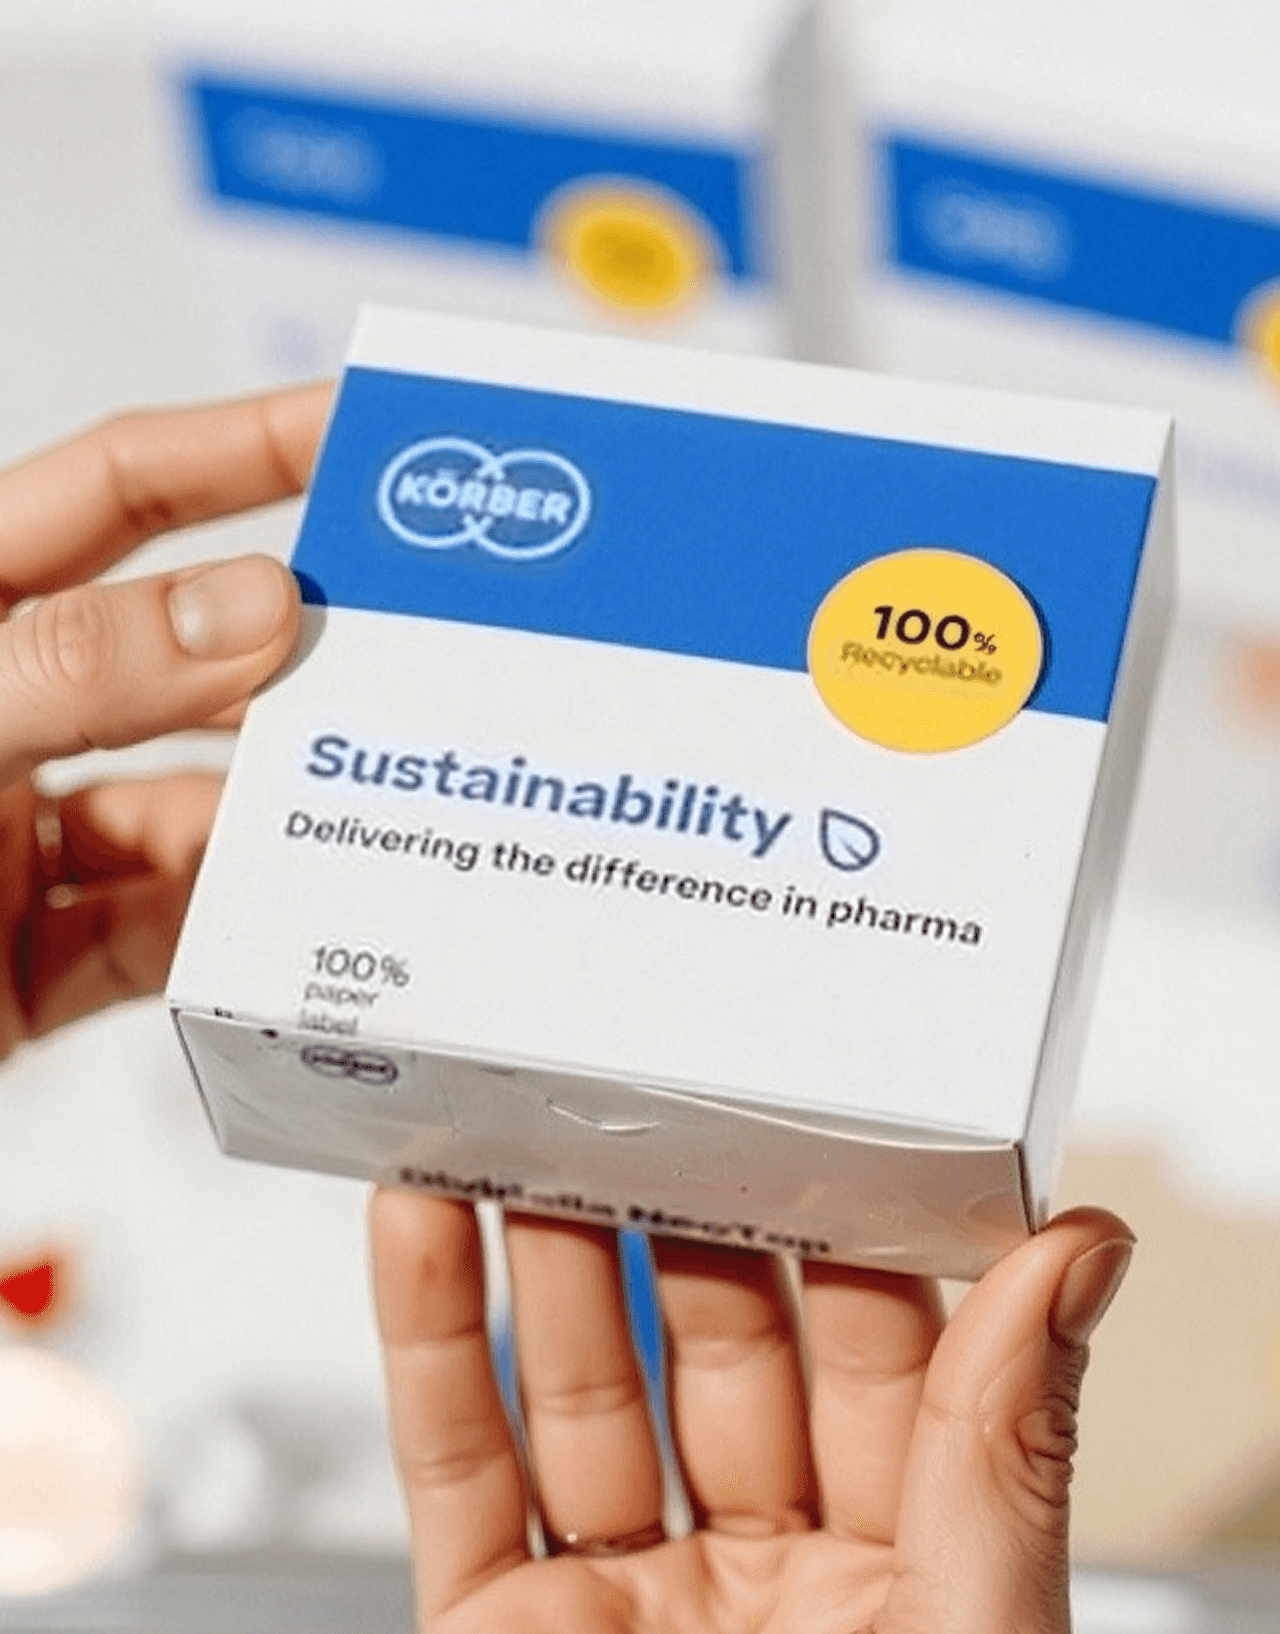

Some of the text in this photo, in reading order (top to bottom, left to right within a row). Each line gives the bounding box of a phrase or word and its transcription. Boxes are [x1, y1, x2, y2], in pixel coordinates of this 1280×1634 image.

[396, 469, 573, 525] KÖRBER
[874, 605, 997, 655] 100%
[841, 641, 1003, 686] Recyclable
[306, 735, 791, 857] Sustainability
[285, 811, 982, 945] Delivering the difference in pharma
[313, 946, 410, 987] 100%
[304, 982, 379, 1007] paper
